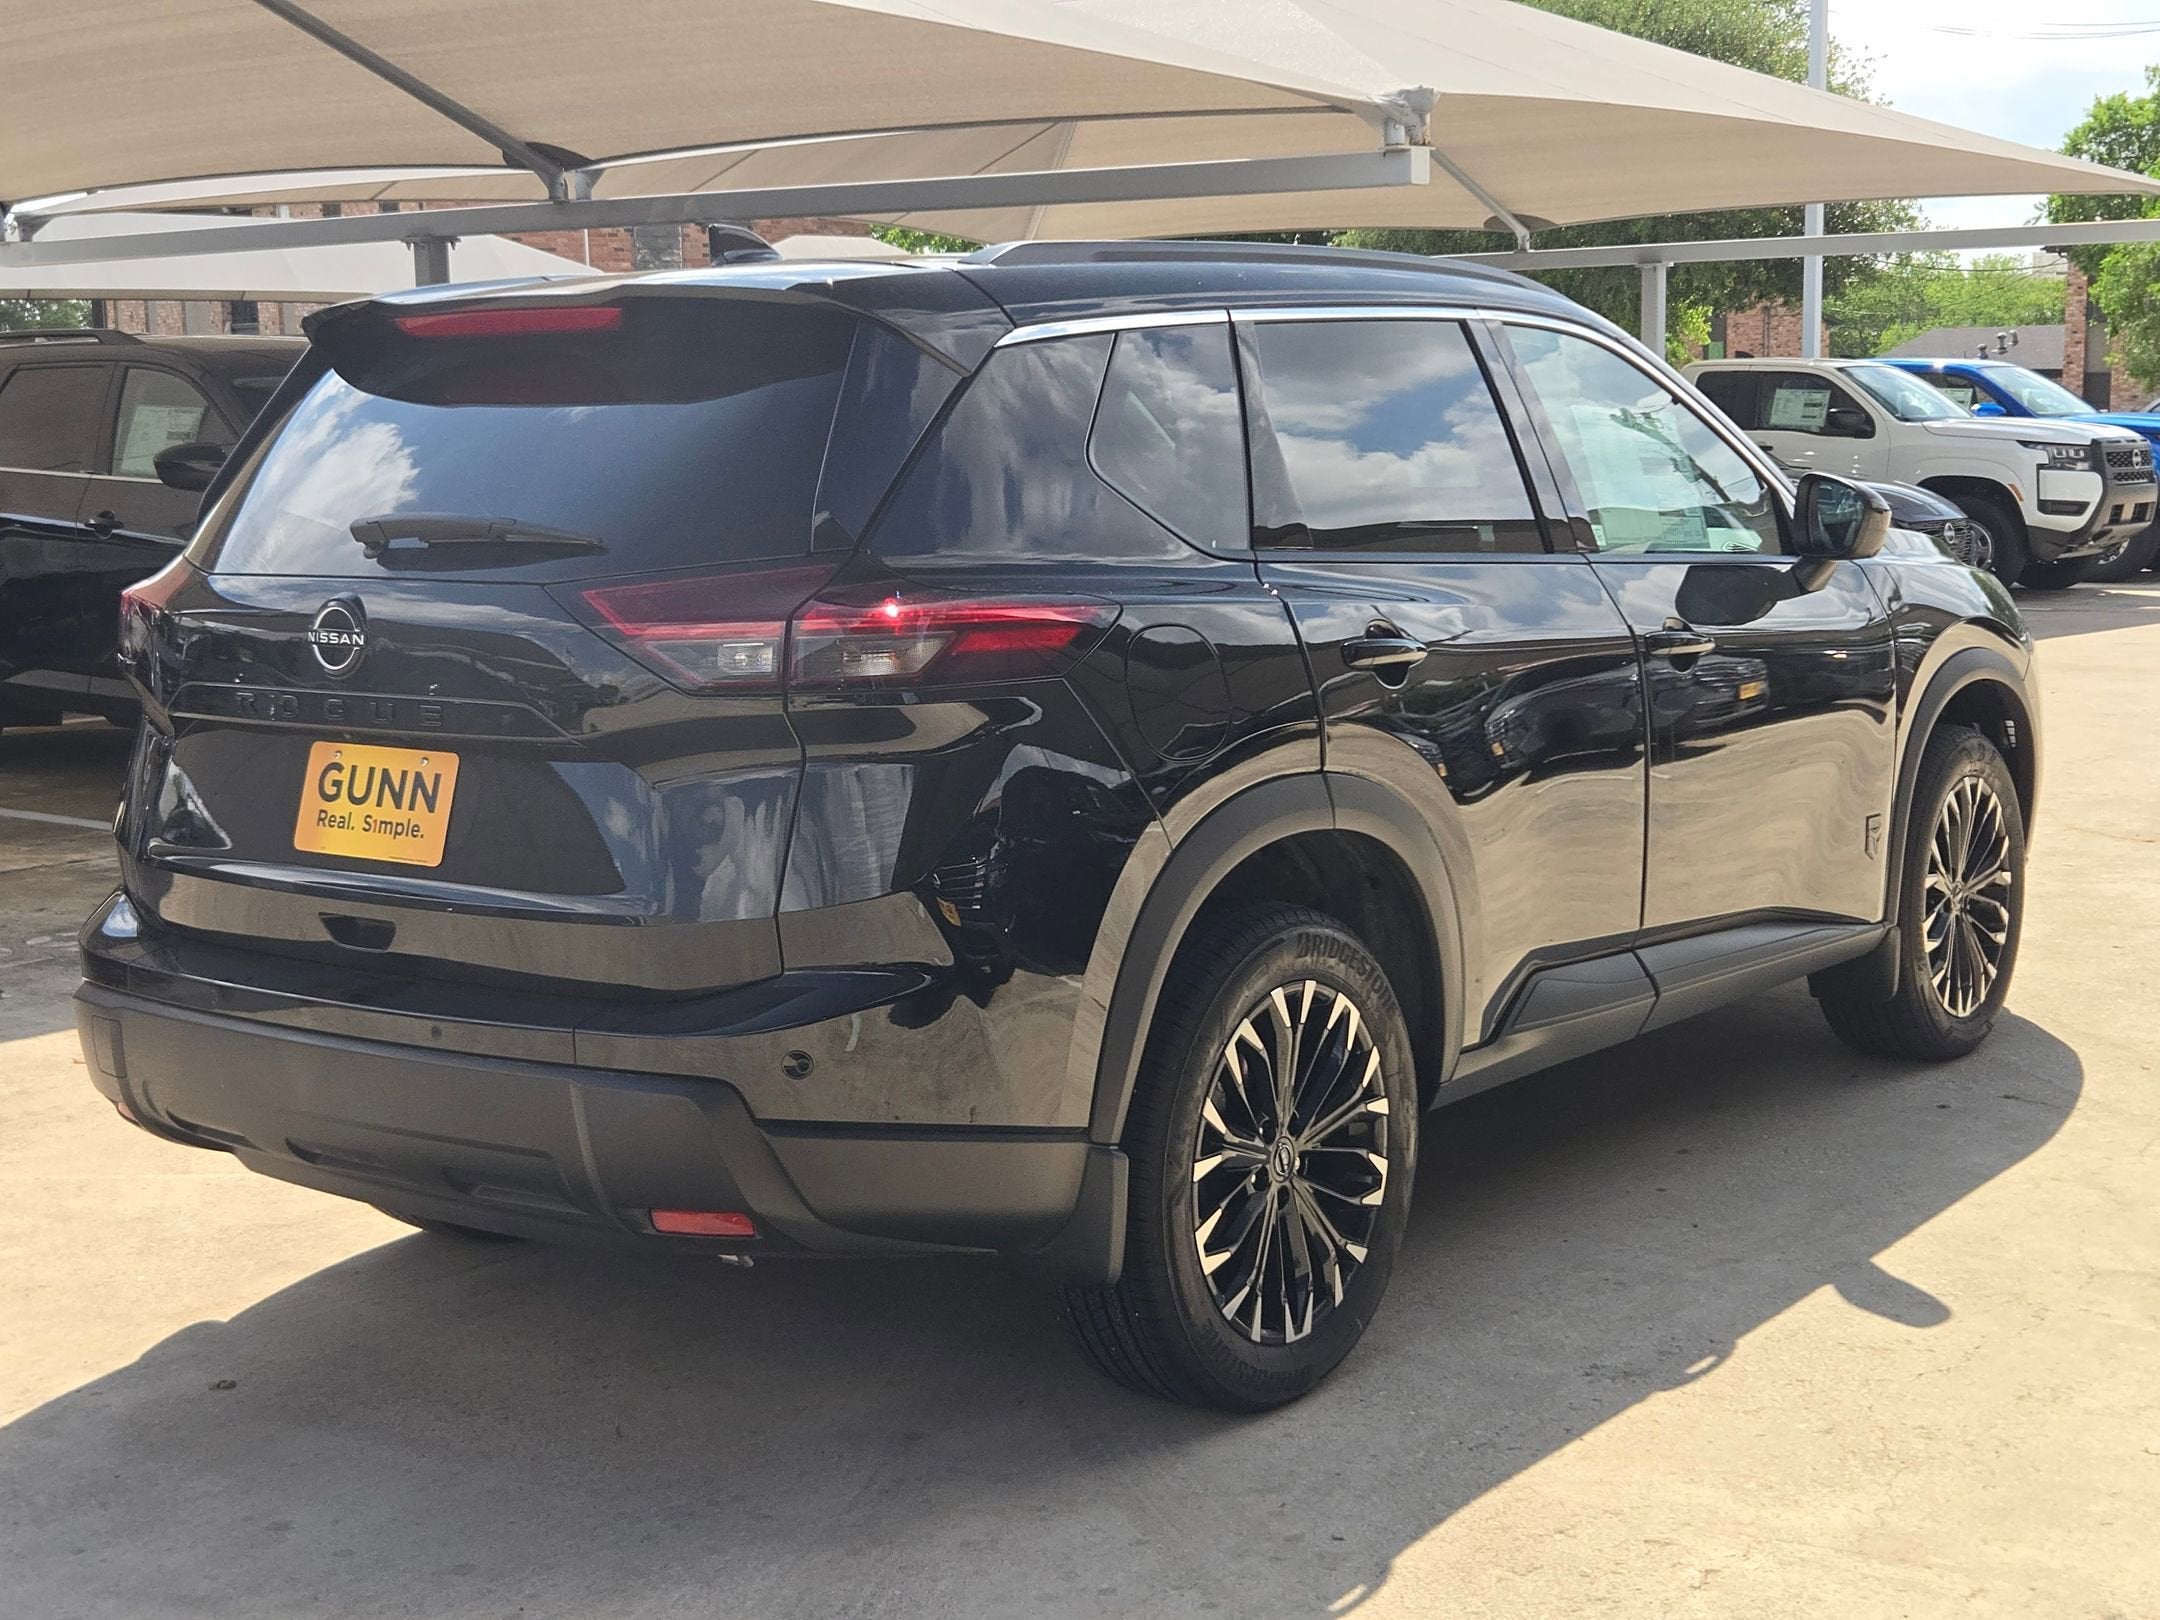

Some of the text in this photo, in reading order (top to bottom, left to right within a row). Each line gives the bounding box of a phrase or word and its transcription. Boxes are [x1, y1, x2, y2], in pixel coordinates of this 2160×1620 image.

[308, 631, 364, 646] NISSAN
[236, 692, 442, 727] ROGUE
[318, 762, 442, 813] GUNN
[316, 809, 355, 831] Real.
